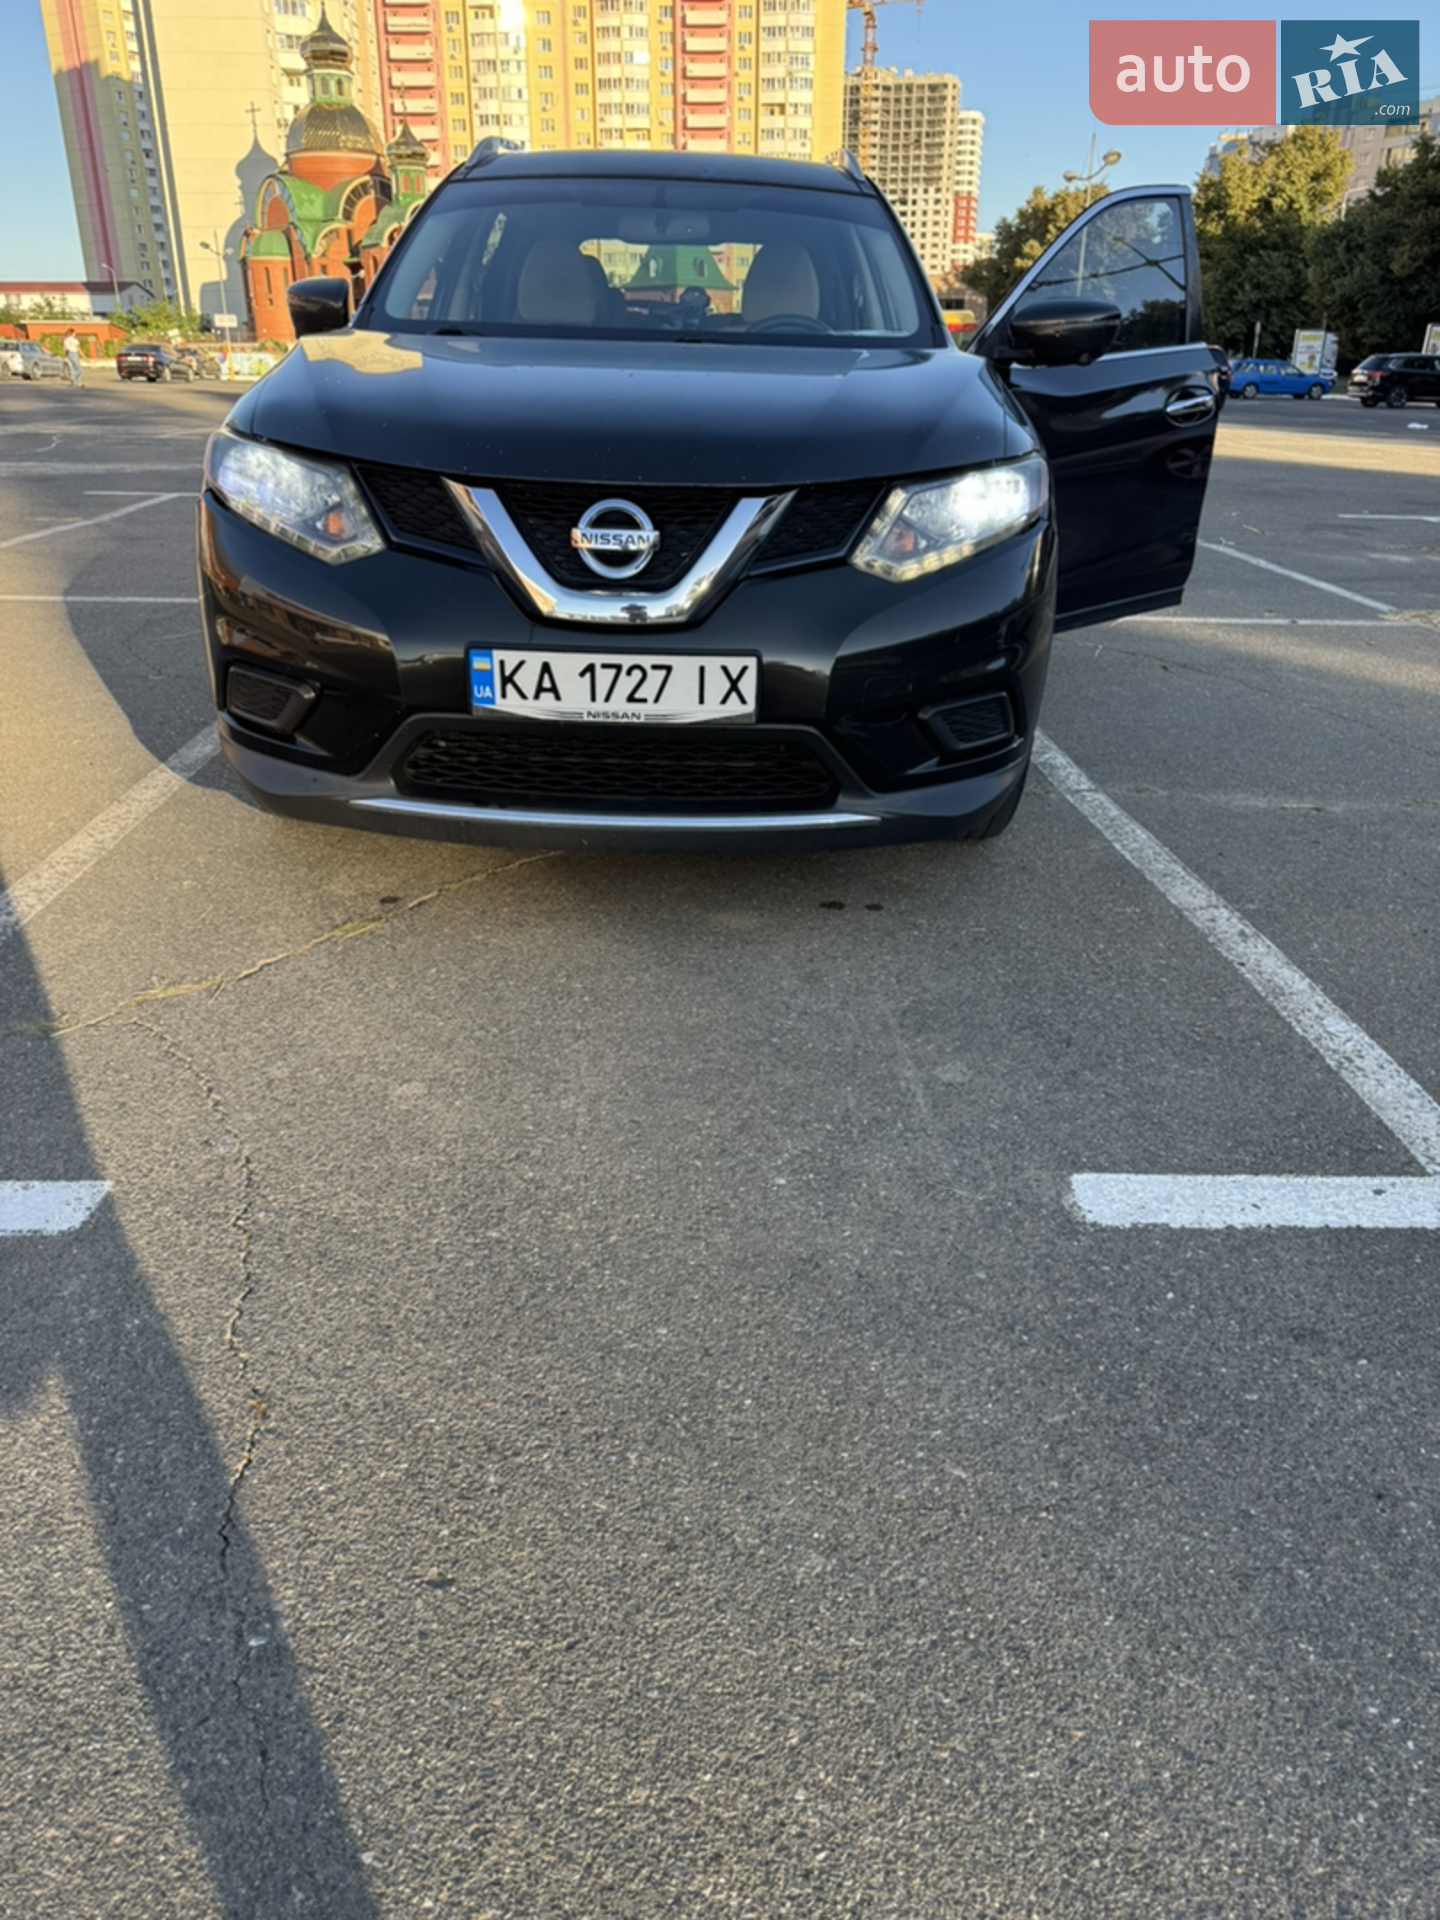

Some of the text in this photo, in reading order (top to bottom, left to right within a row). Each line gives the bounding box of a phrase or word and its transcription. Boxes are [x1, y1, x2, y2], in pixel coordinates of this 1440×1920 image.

[581, 532, 650, 547] NISSAN
[499, 659, 750, 706] KA 1727 IX
[474, 685, 493, 698] UA
[586, 710, 642, 721] NISSAN
